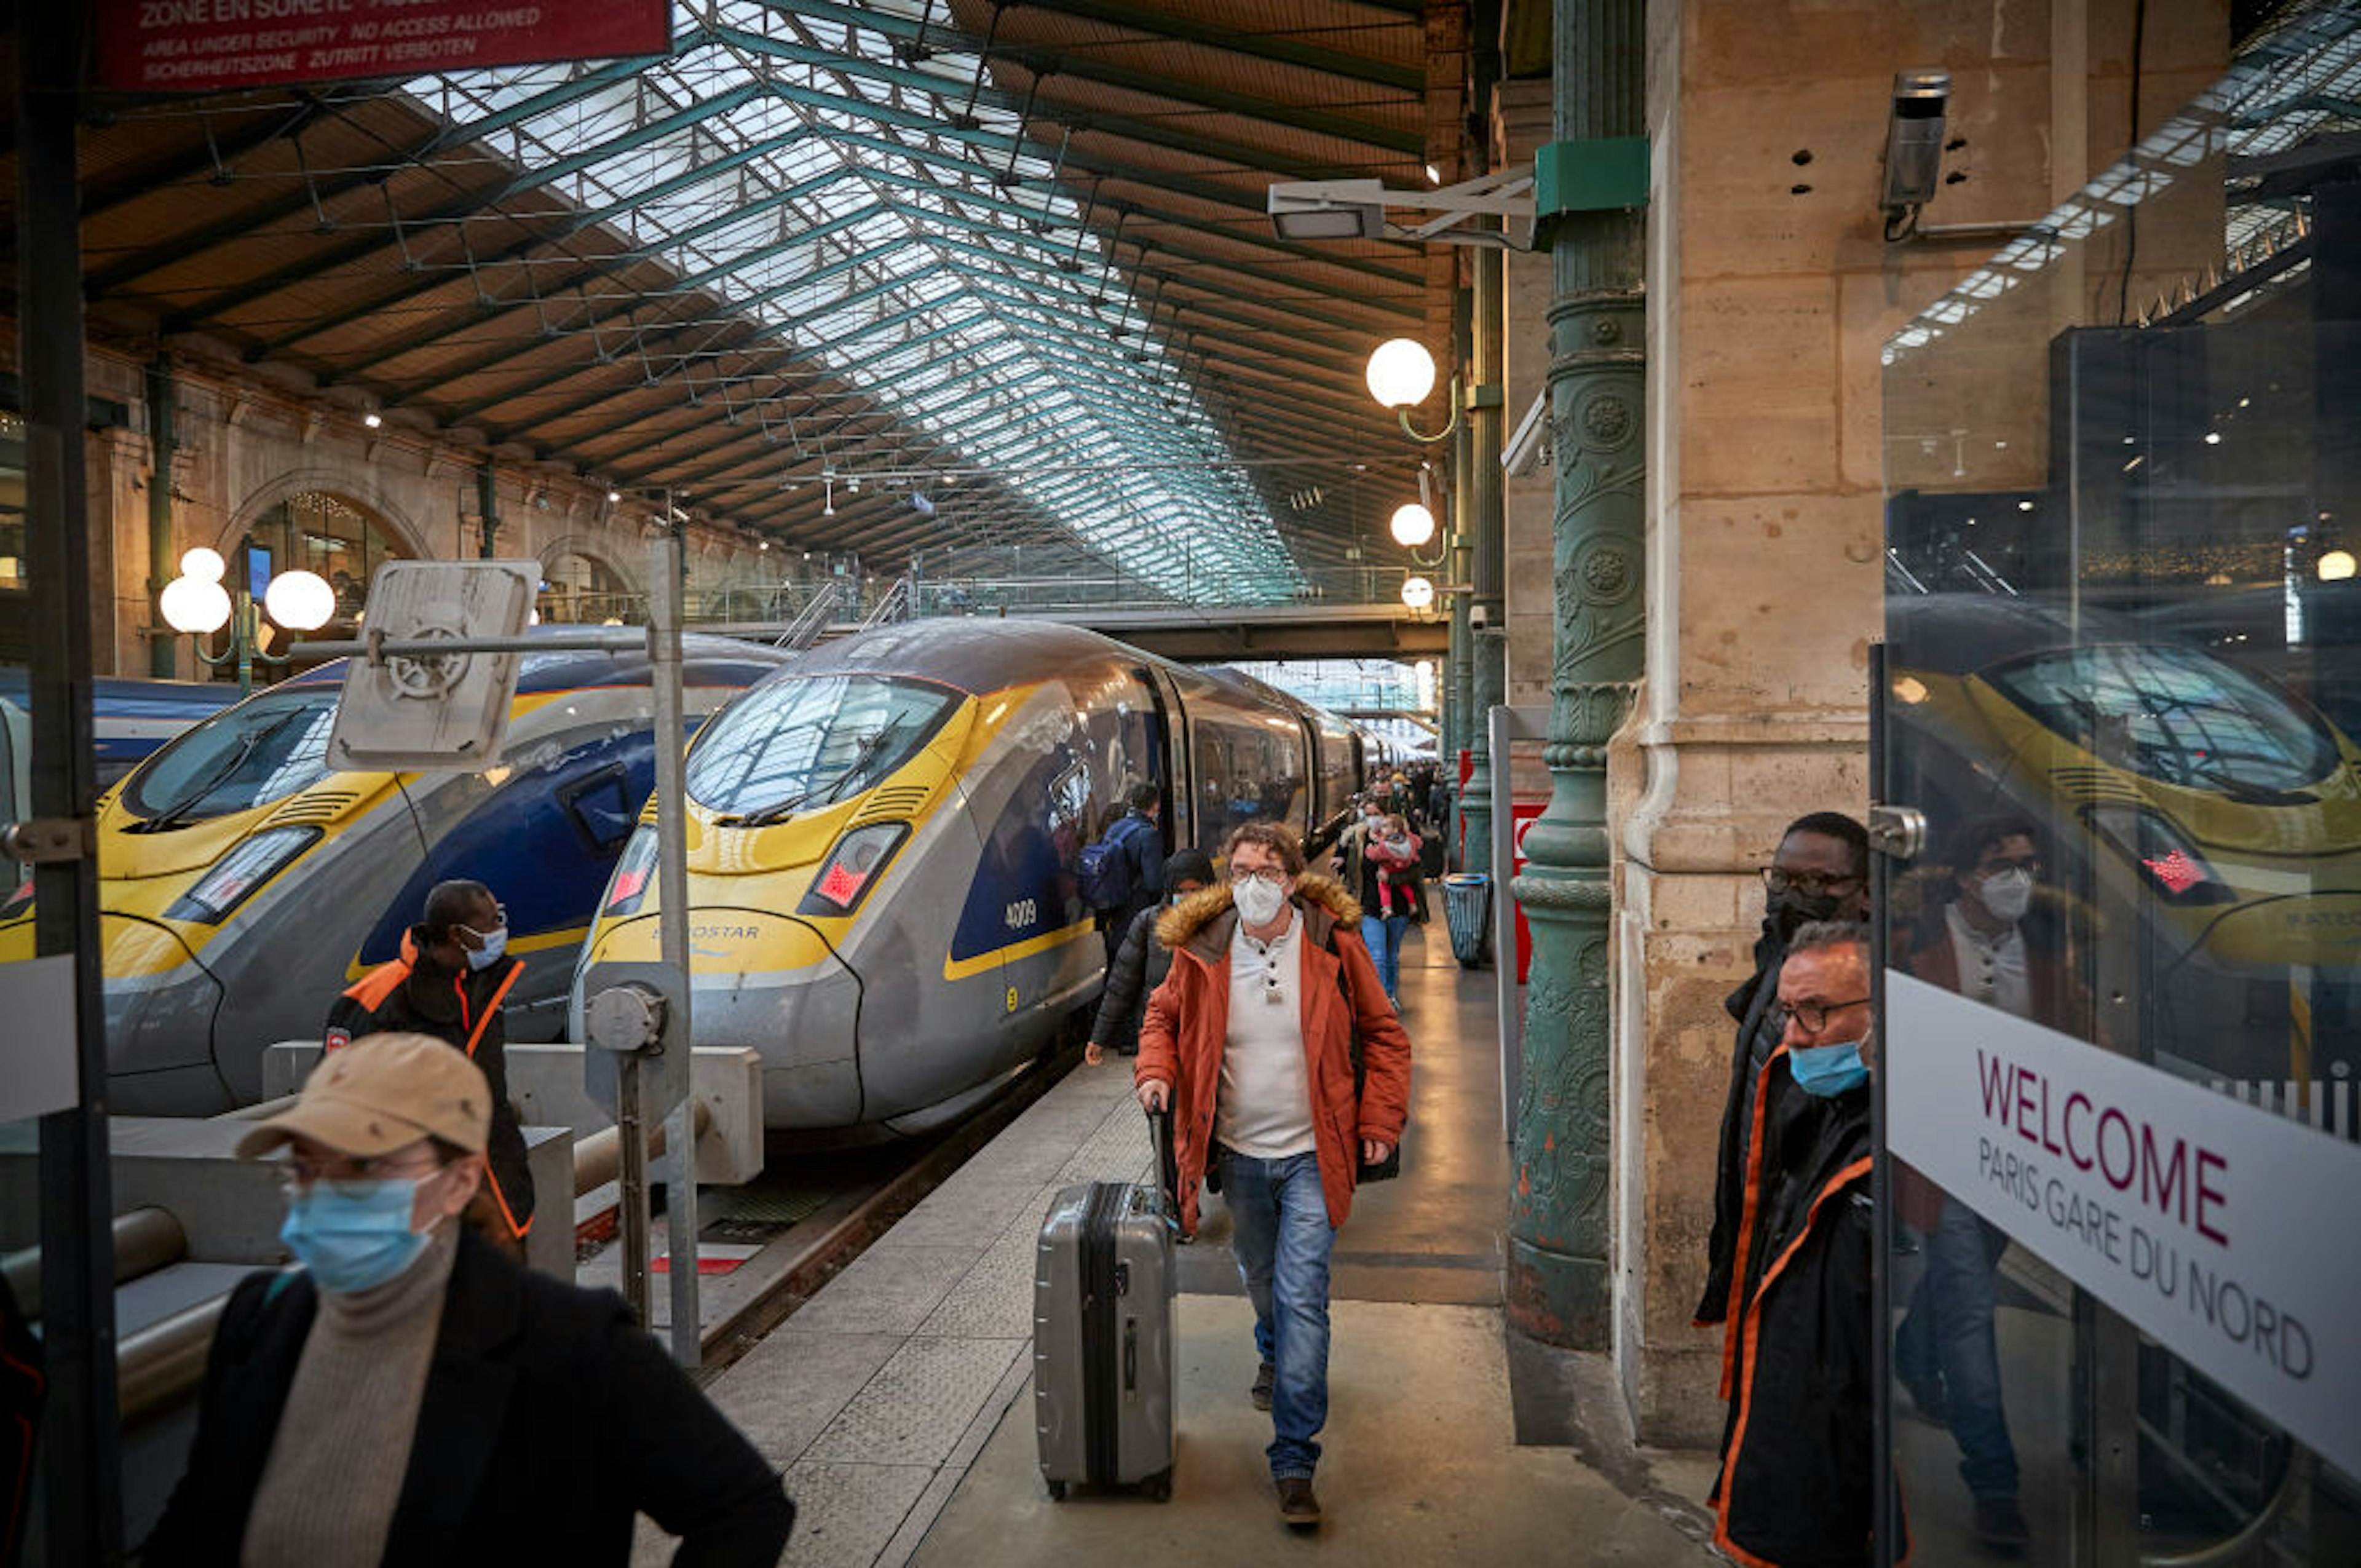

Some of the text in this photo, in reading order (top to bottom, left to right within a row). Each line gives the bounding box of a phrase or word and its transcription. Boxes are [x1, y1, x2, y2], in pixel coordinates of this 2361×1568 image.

[138, 0, 209, 29] ZONE
[215, 0, 251, 22] EN
[144, 7, 540, 57] AREA UNDER SECURITY NO ACCESS ALLOWED
[145, 38, 477, 80] SICHERHEITSZONE ZUTRITT VERBOTEN
[1005, 898, 1037, 929] 4009
[1978, 1050, 2228, 1247] WELCOME
[1979, 1138, 2314, 1380] PARIS GARE DU NORD
